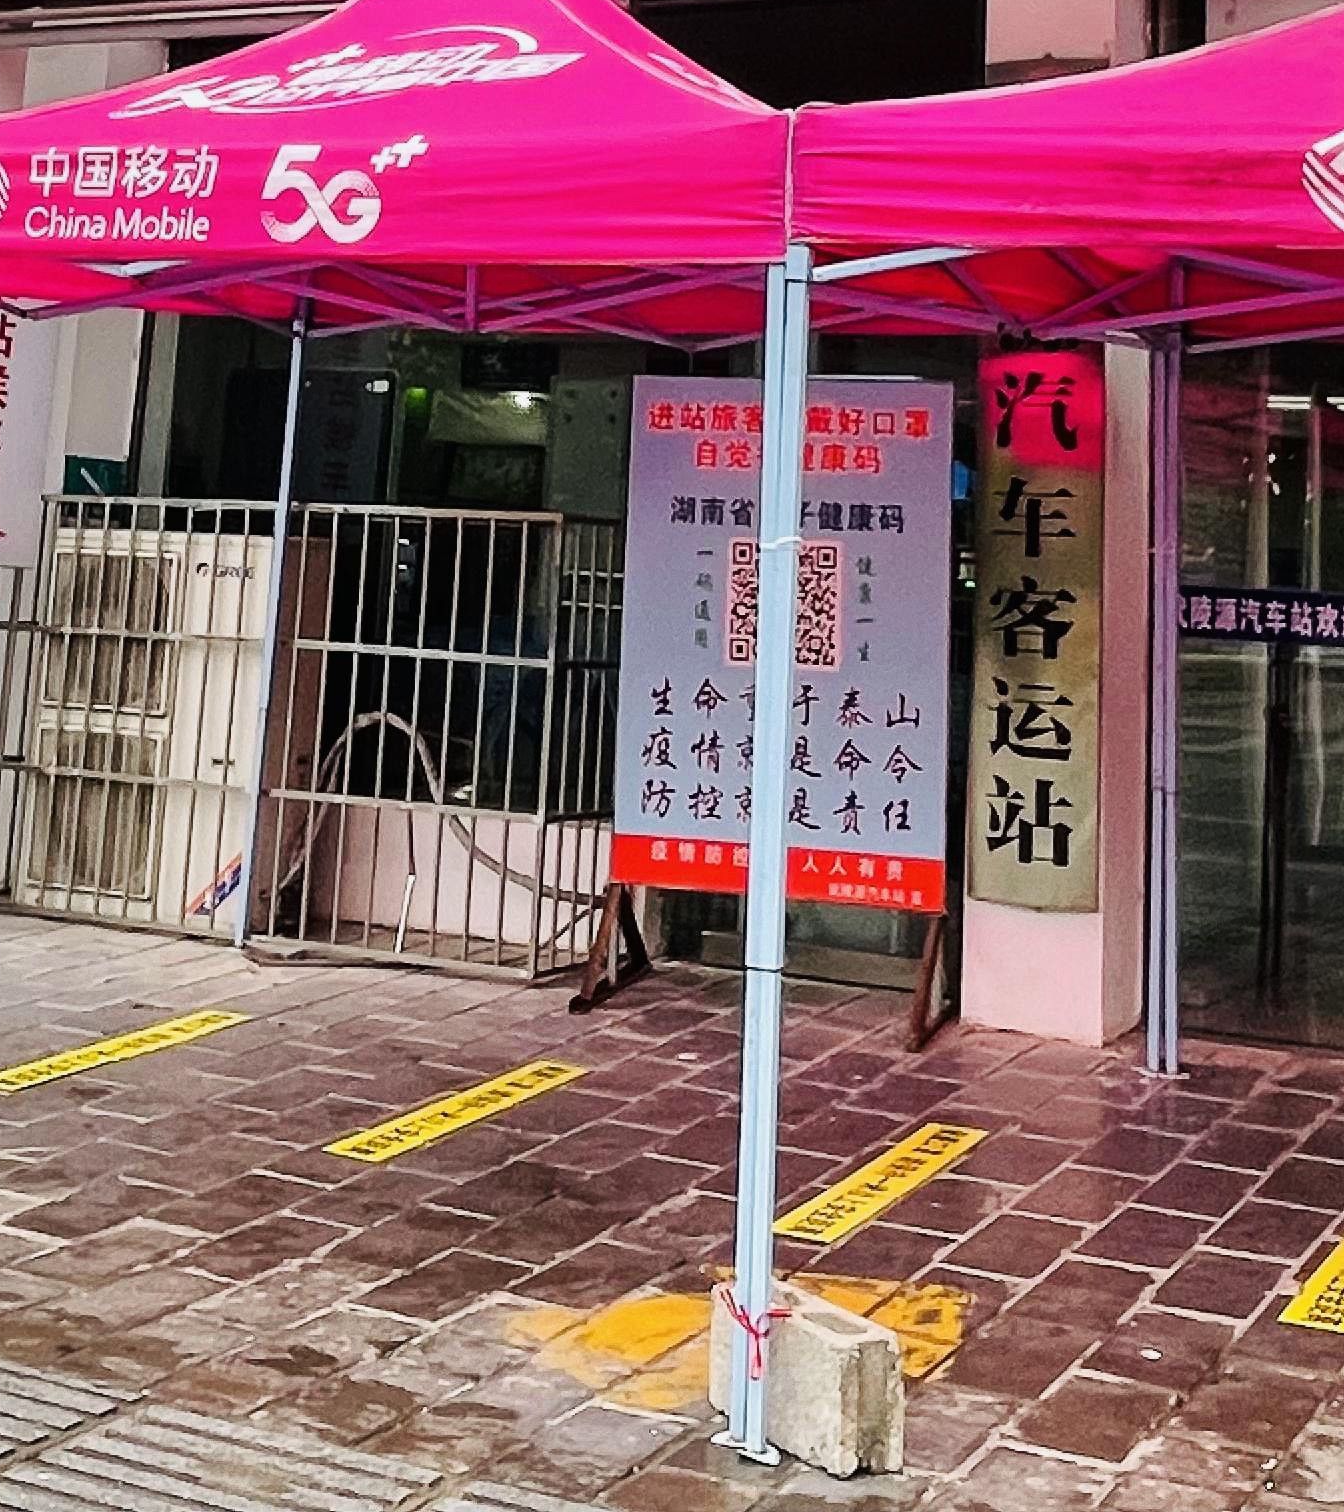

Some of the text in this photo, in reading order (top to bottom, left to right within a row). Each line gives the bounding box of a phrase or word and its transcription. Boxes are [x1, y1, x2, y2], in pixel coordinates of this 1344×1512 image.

[26, 146, 219, 202] 中国移动
[23, 203, 211, 244] China Mobile
[648, 402, 930, 438] 进站旅客戴好口罩
[985, 332, 1080, 869] 汽车客运站
